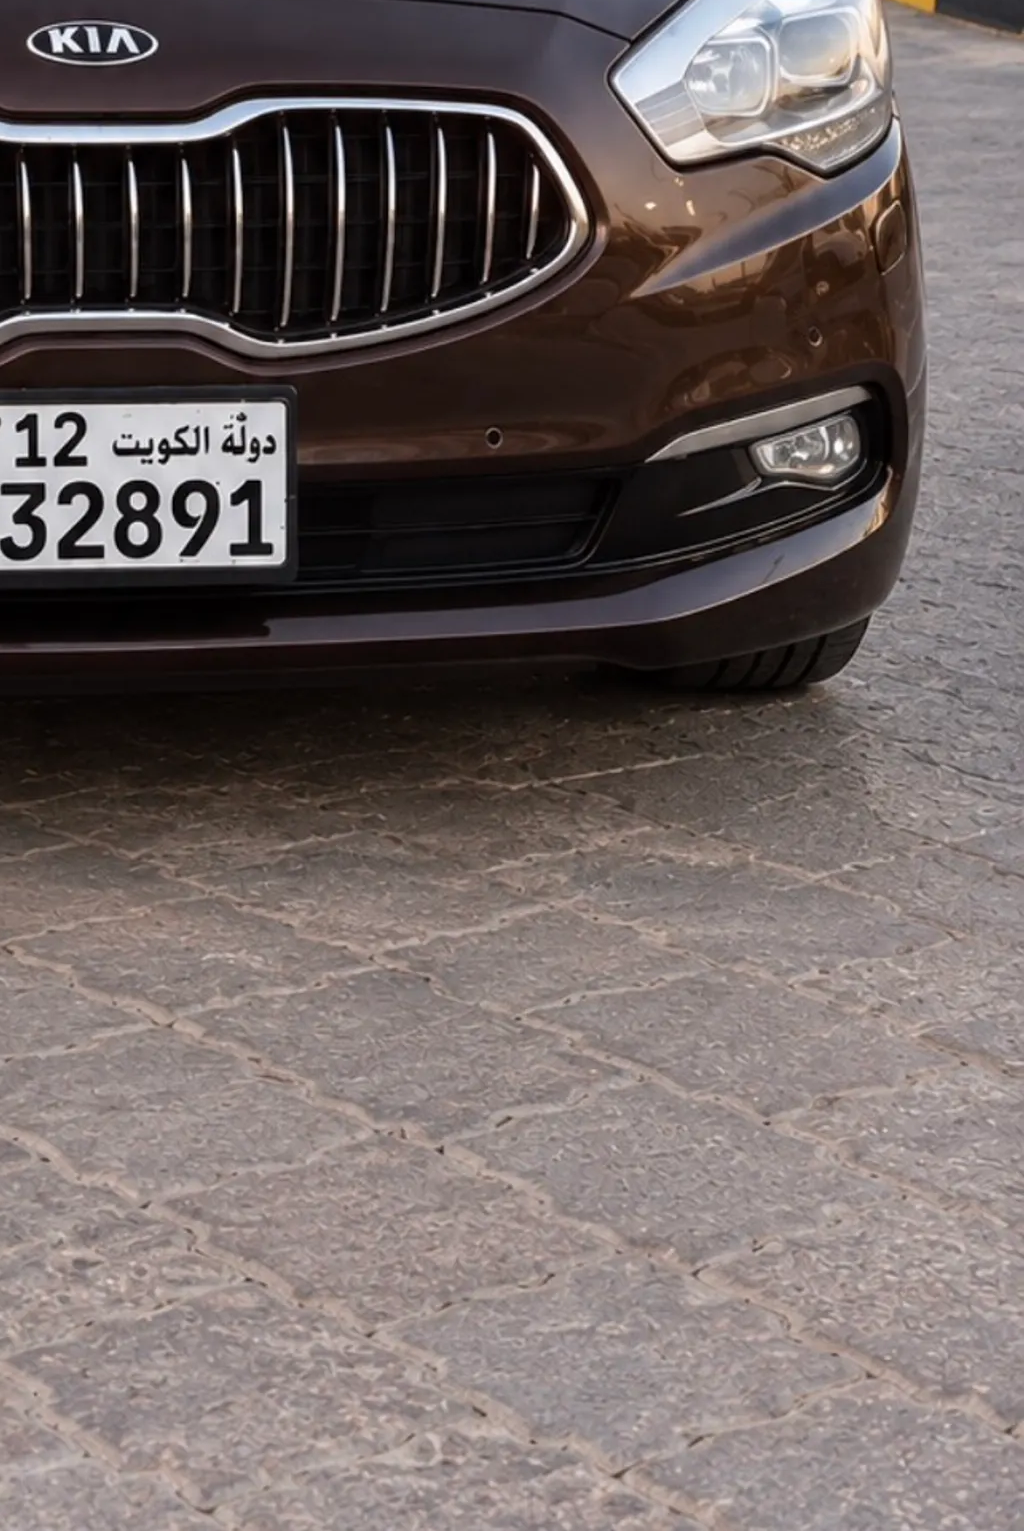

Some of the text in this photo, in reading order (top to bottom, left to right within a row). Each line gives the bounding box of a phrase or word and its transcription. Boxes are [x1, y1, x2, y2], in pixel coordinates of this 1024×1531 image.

[48, 26, 140, 54] KIA
[14, 412, 88, 467] 12
[112, 412, 277, 465] دولة الكويت
[0, 479, 274, 561] 32891
